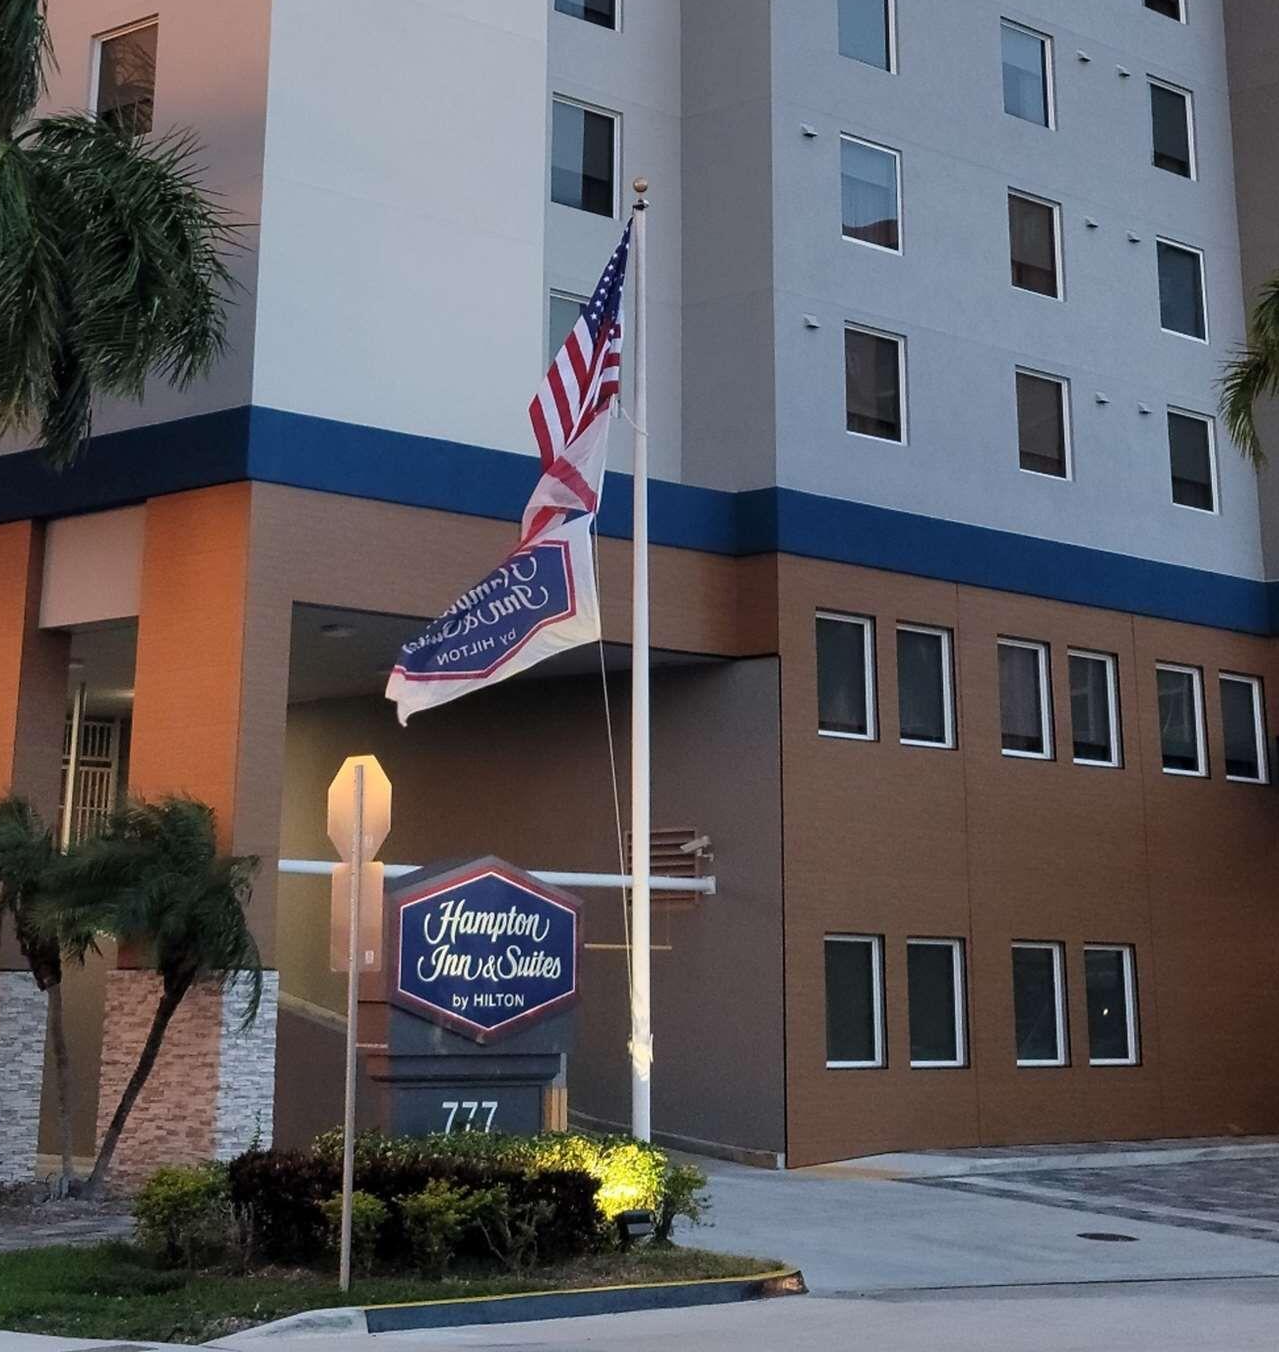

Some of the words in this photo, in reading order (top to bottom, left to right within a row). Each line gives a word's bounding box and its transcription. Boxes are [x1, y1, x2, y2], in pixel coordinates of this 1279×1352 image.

[424, 899, 550, 944] Hampton
[417, 944, 483, 982] Inn
[482, 955, 499, 982] &
[497, 945, 561, 979] Suites
[452, 993, 469, 1010] by
[473, 994, 525, 1007] HILTON
[442, 1101, 498, 1135] 777
